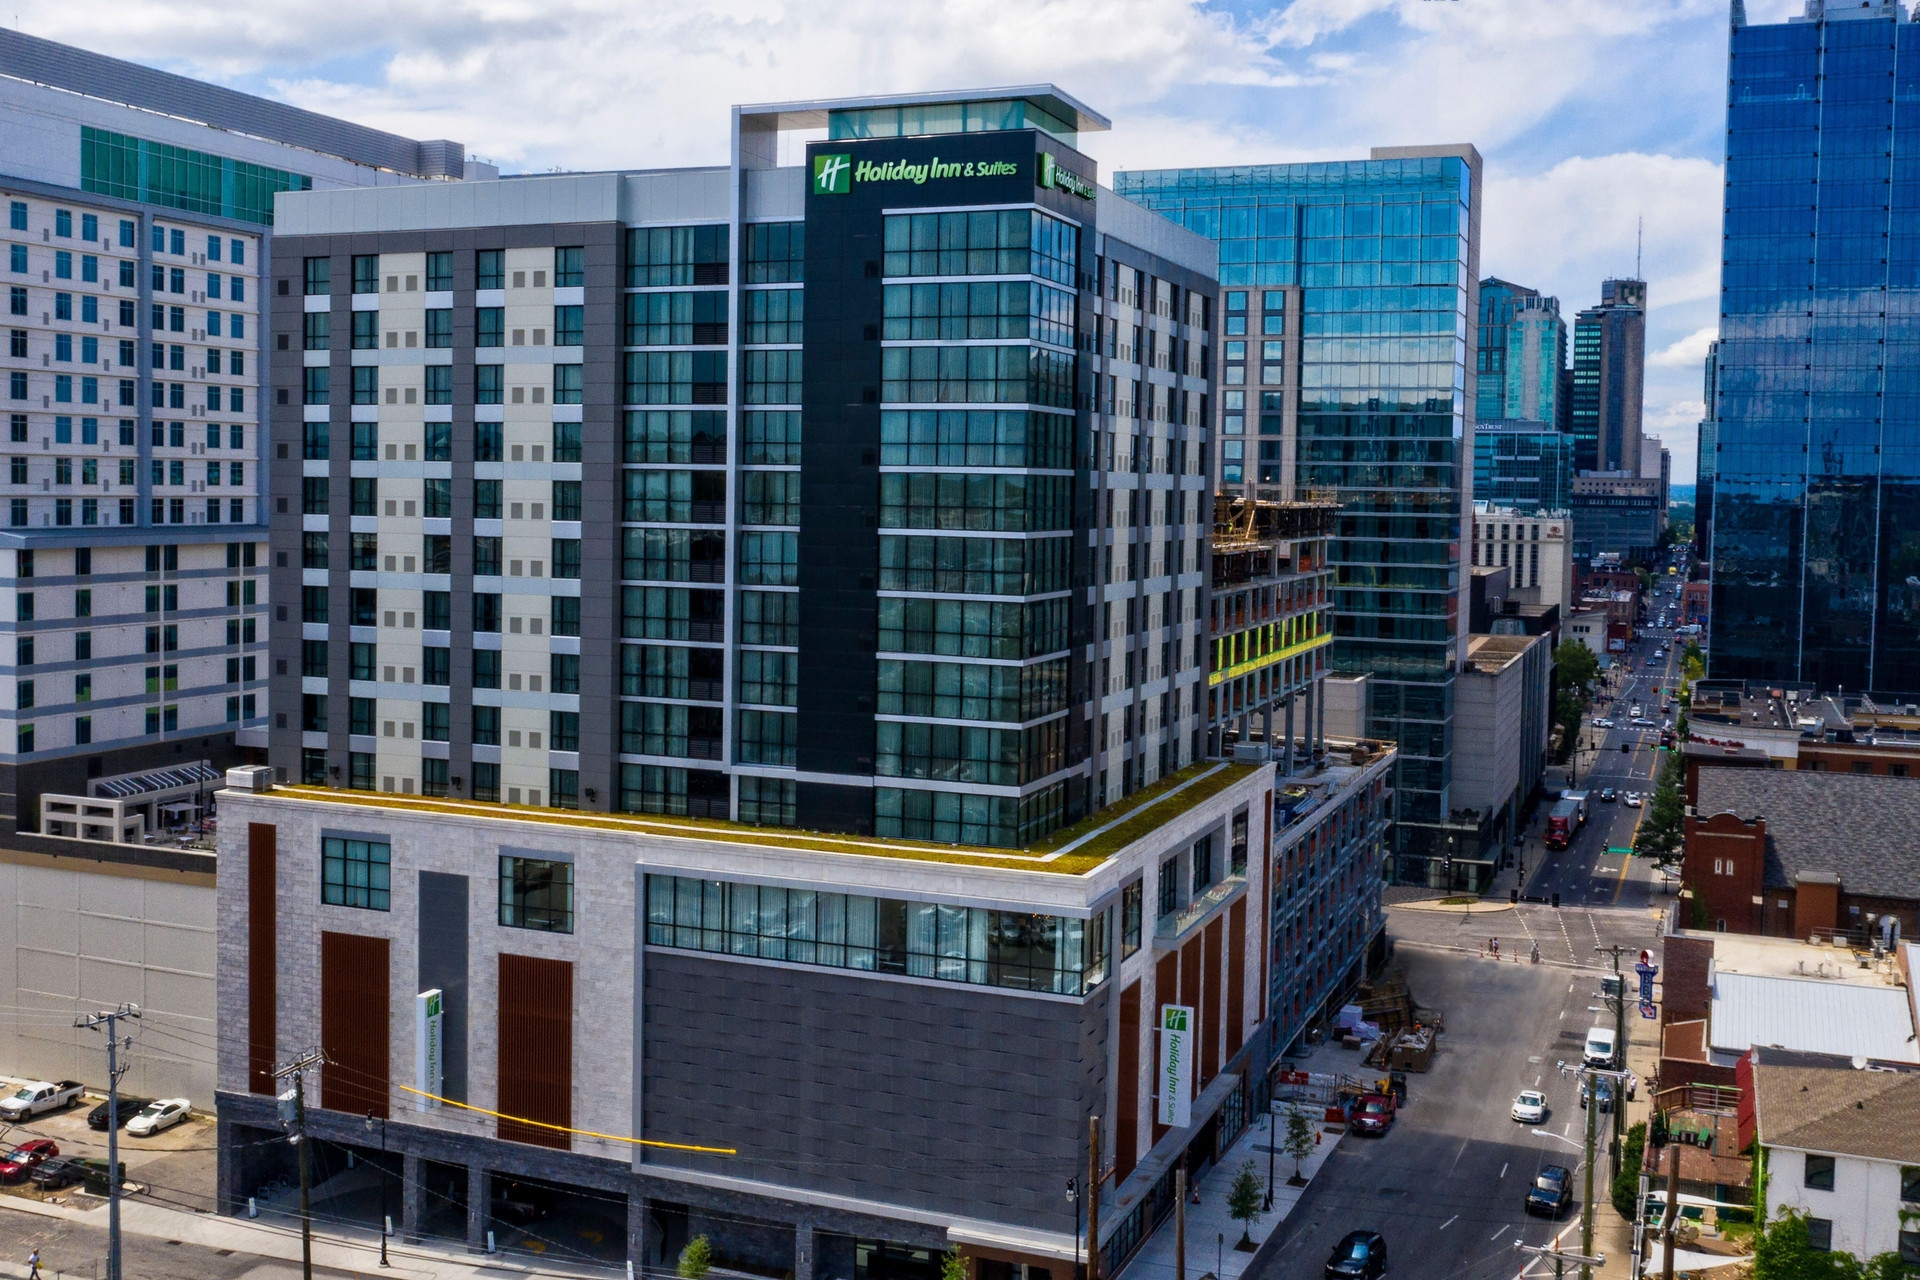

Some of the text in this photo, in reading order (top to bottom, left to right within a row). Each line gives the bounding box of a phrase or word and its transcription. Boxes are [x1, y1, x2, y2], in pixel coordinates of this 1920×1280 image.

[855, 157, 1018, 185] Holiday Inn & Suites
[1055, 165, 1076, 194] Holiday
[428, 1020, 437, 1061] Holiday
[1167, 1033, 1182, 1077] Holiday
[1168, 1077, 1180, 1094] Inn
[1167, 1102, 1176, 1124] Suites
